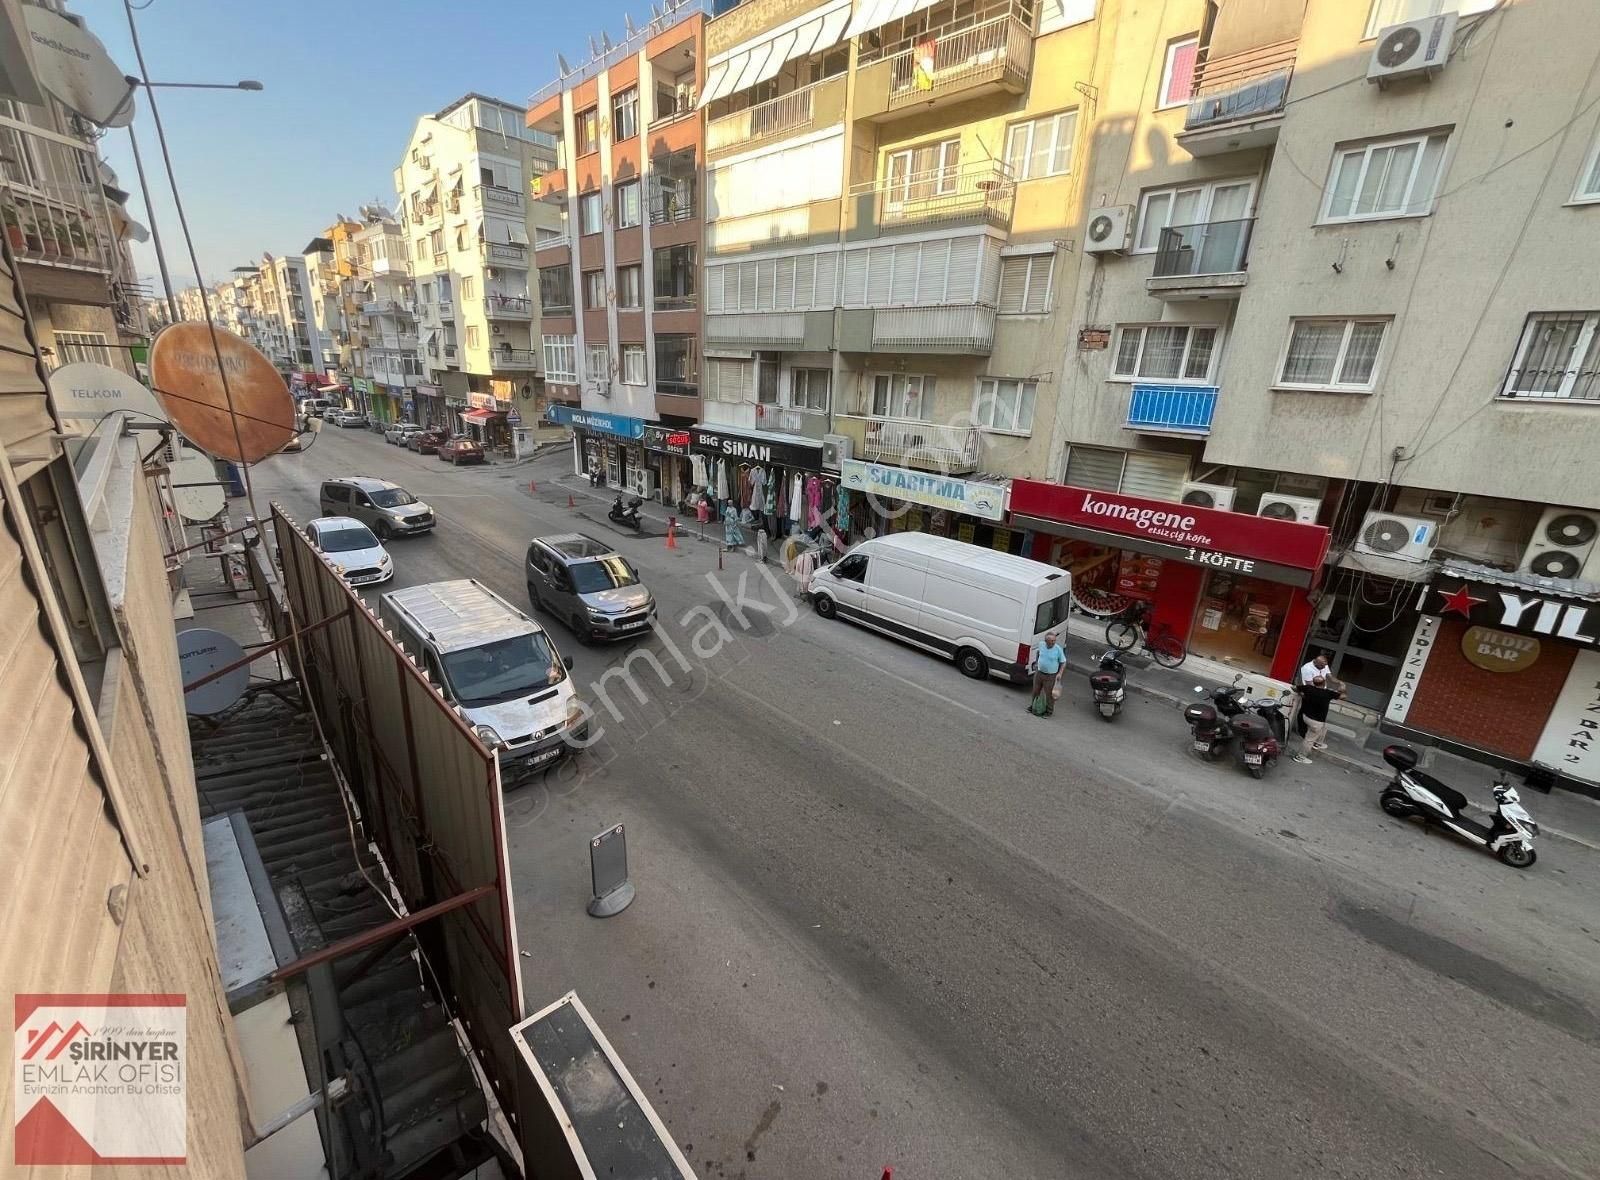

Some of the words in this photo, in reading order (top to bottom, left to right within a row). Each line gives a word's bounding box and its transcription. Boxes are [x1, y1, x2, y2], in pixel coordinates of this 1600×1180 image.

[71, 389, 122, 399] TELKOM
[870, 468, 892, 485] SU
[895, 473, 966, 501] ARITMA
[1081, 493, 1196, 531] komagene
[1147, 527, 1170, 537] etsiz
[1169, 531, 1184, 541] çiğ
[1185, 532, 1212, 545] köfte
[1199, 551, 1255, 573] KÖFTE
[1498, 592, 1600, 645] YIL
[1473, 630, 1536, 652] YILDIZ
[1477, 644, 1520, 662] BAR
[1396, 671, 1415, 699] BAR
[1393, 703, 1404, 711] 2
[1568, 718, 1598, 751] BAR
[1563, 753, 1580, 764] 2
